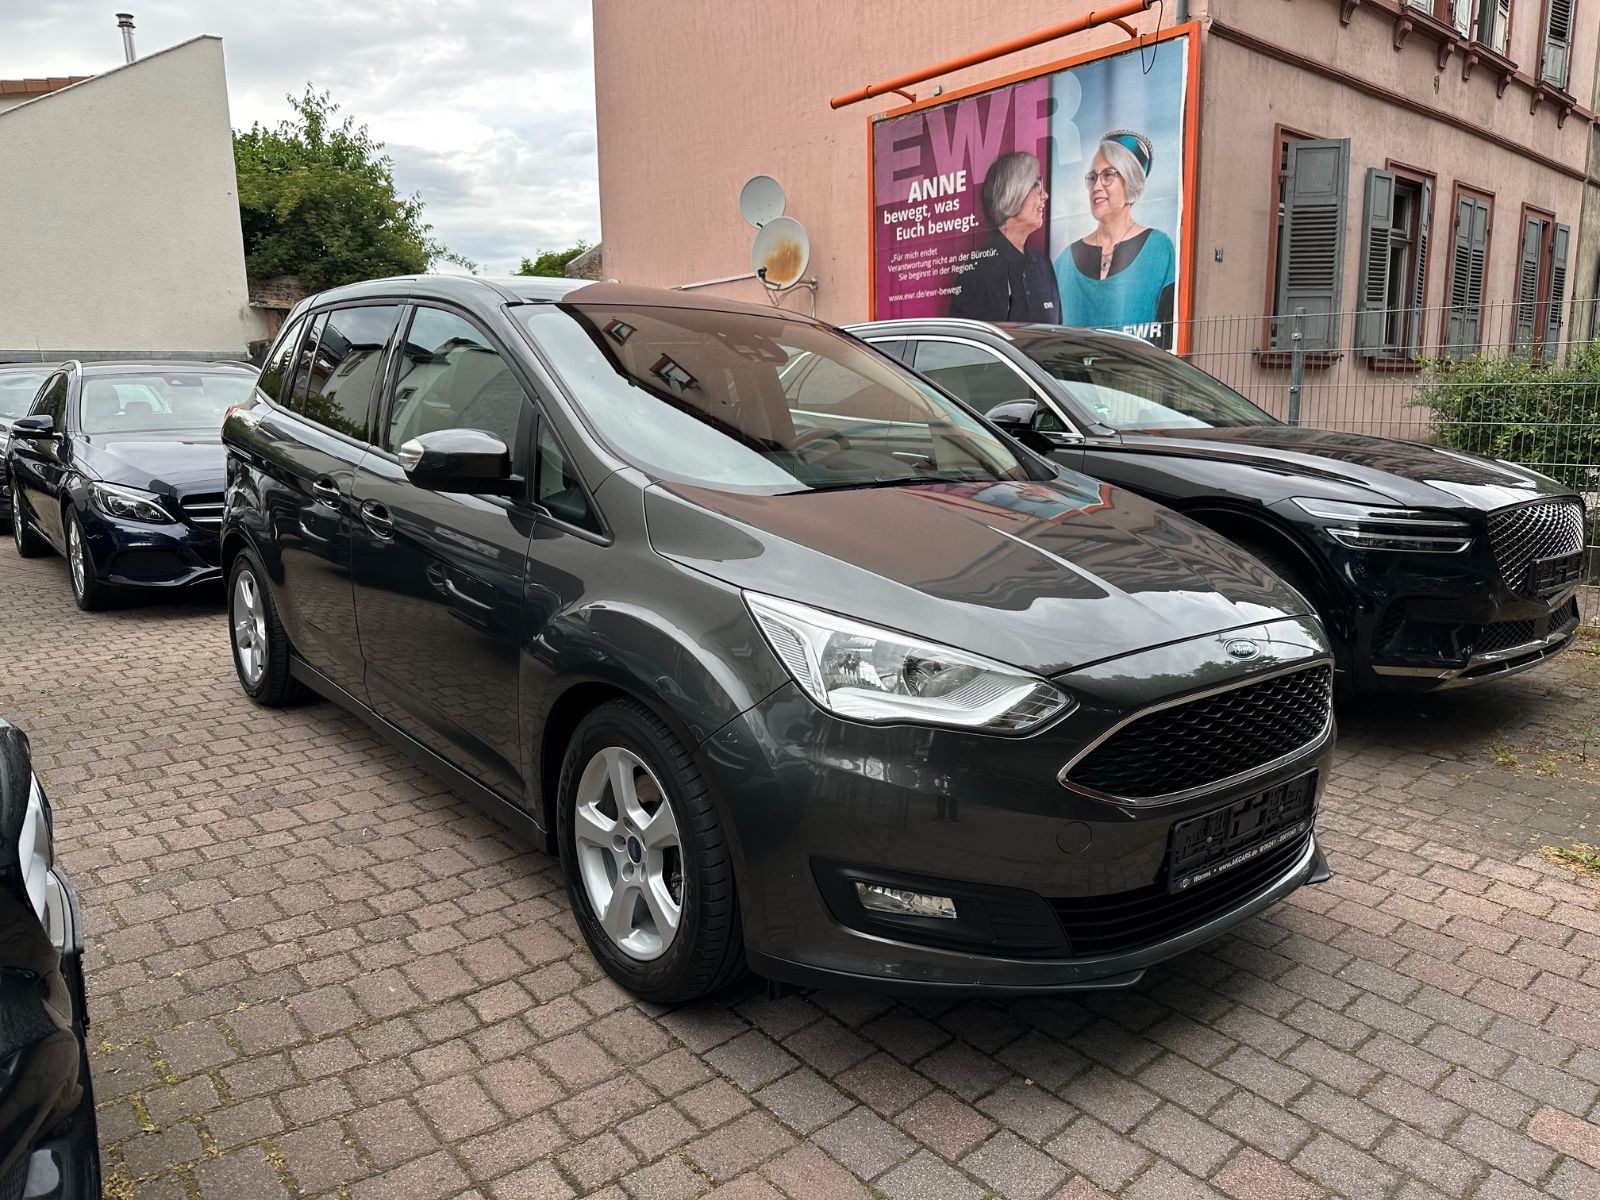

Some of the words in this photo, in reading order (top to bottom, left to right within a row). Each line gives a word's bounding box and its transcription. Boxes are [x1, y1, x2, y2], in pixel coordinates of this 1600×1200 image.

[875, 70, 1083, 206] EWR
[908, 170, 967, 203] ANNE
[884, 203, 931, 225] bewegt,
[934, 199, 960, 215] was
[896, 222, 925, 241] Euch
[928, 213, 978, 232] bewegt.
[887, 259, 932, 273] Verantwortung
[932, 255, 948, 267] nicht
[958, 252, 969, 262] der
[970, 248, 999, 260] Bürotür.
[904, 251, 920, 260] mich
[920, 247, 938, 257] endet
[898, 273, 908, 281] Sie
[908, 268, 931, 281] beginnt
[932, 267, 938, 275] in
[939, 265, 950, 275] der
[888, 285, 962, 301] www.ewr.de/ewr-bewegt
